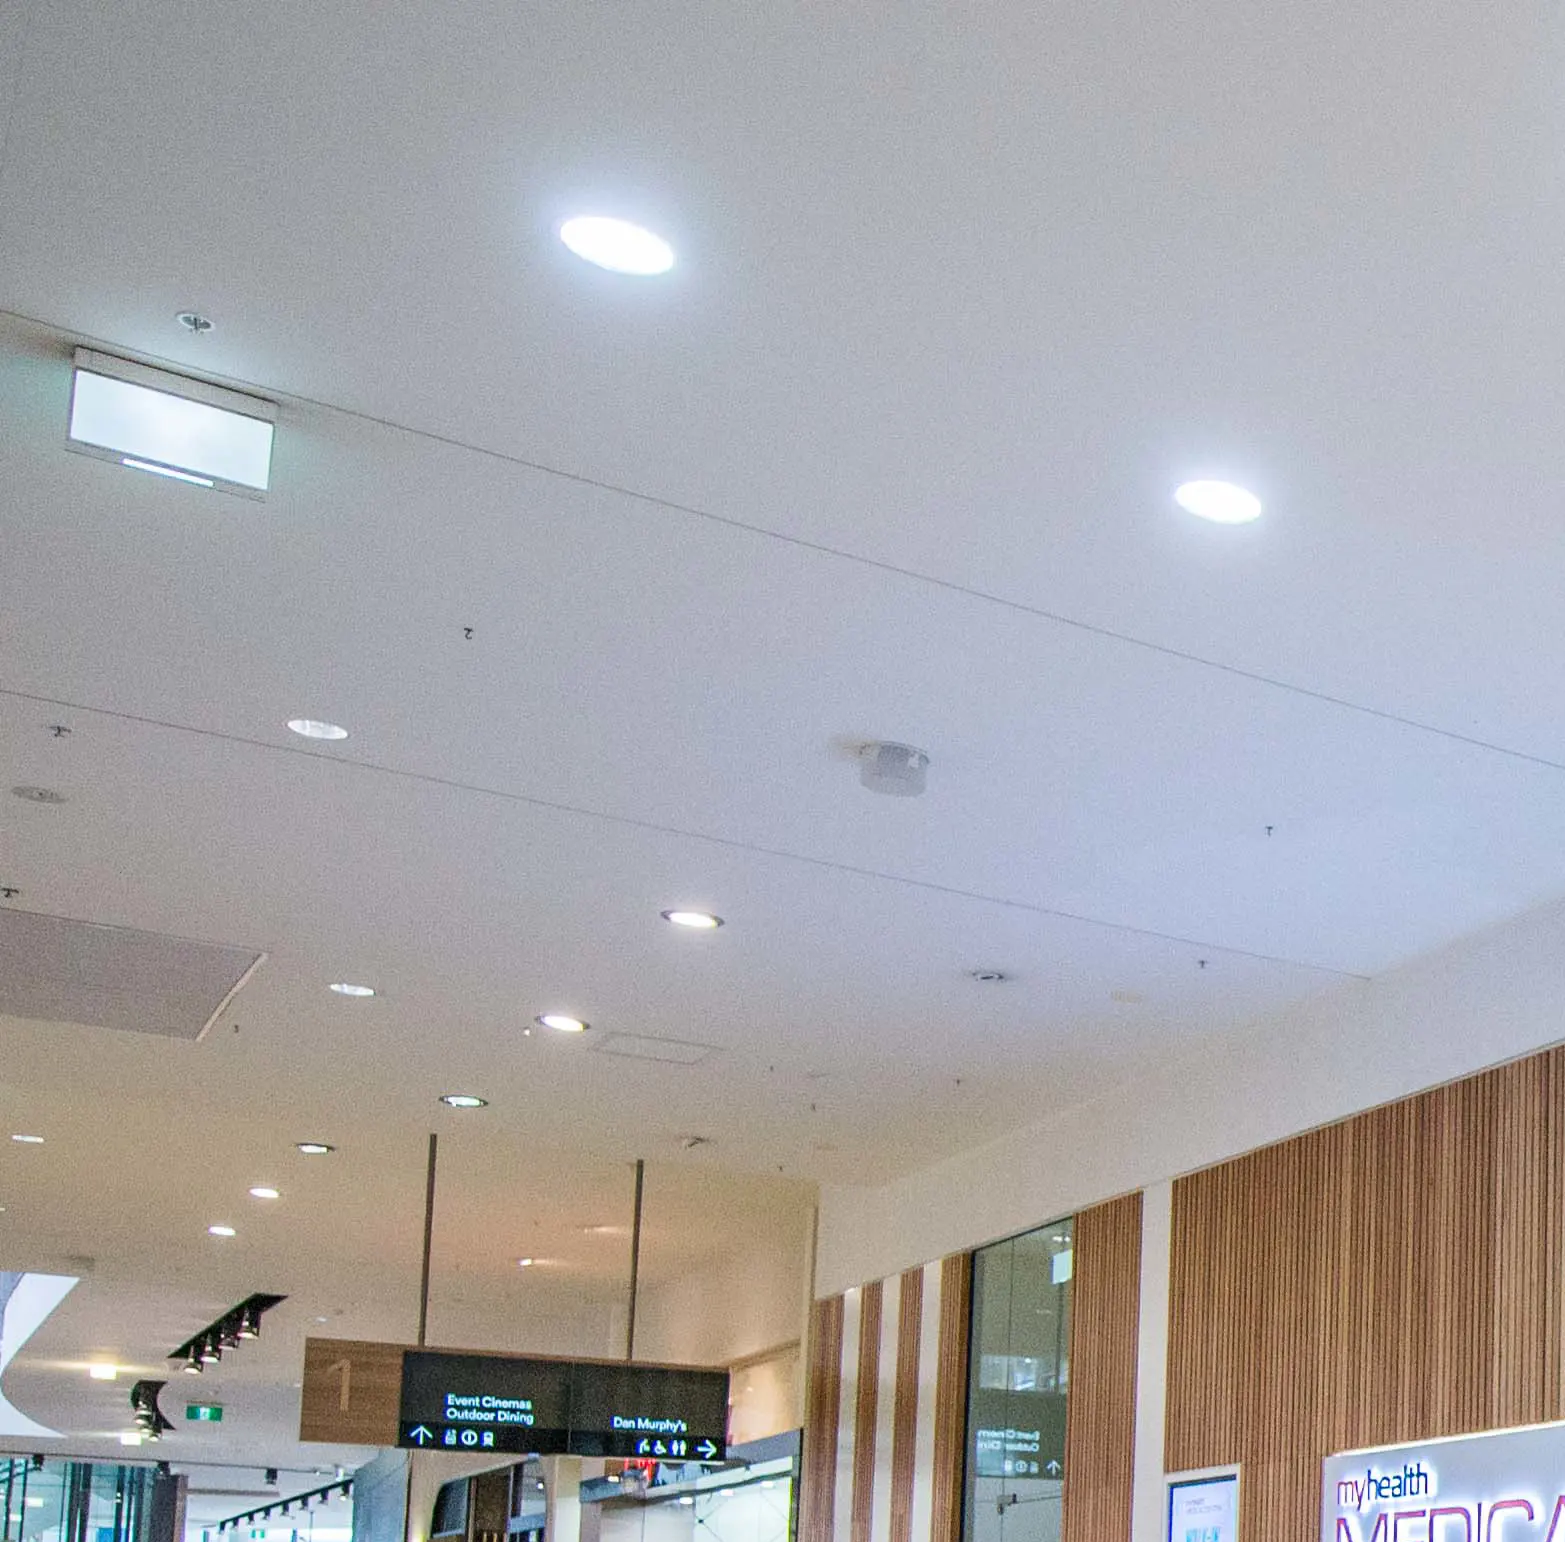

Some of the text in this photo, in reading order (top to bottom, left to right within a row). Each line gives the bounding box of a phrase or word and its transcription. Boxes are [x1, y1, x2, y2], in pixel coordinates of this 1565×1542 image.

[446, 1393, 532, 1410] Event Cinemas
[445, 1407, 534, 1426] Outdoor Dining
[612, 1415, 688, 1433] Dan Murphy's
[1337, 1463, 1428, 1511] myhealth
